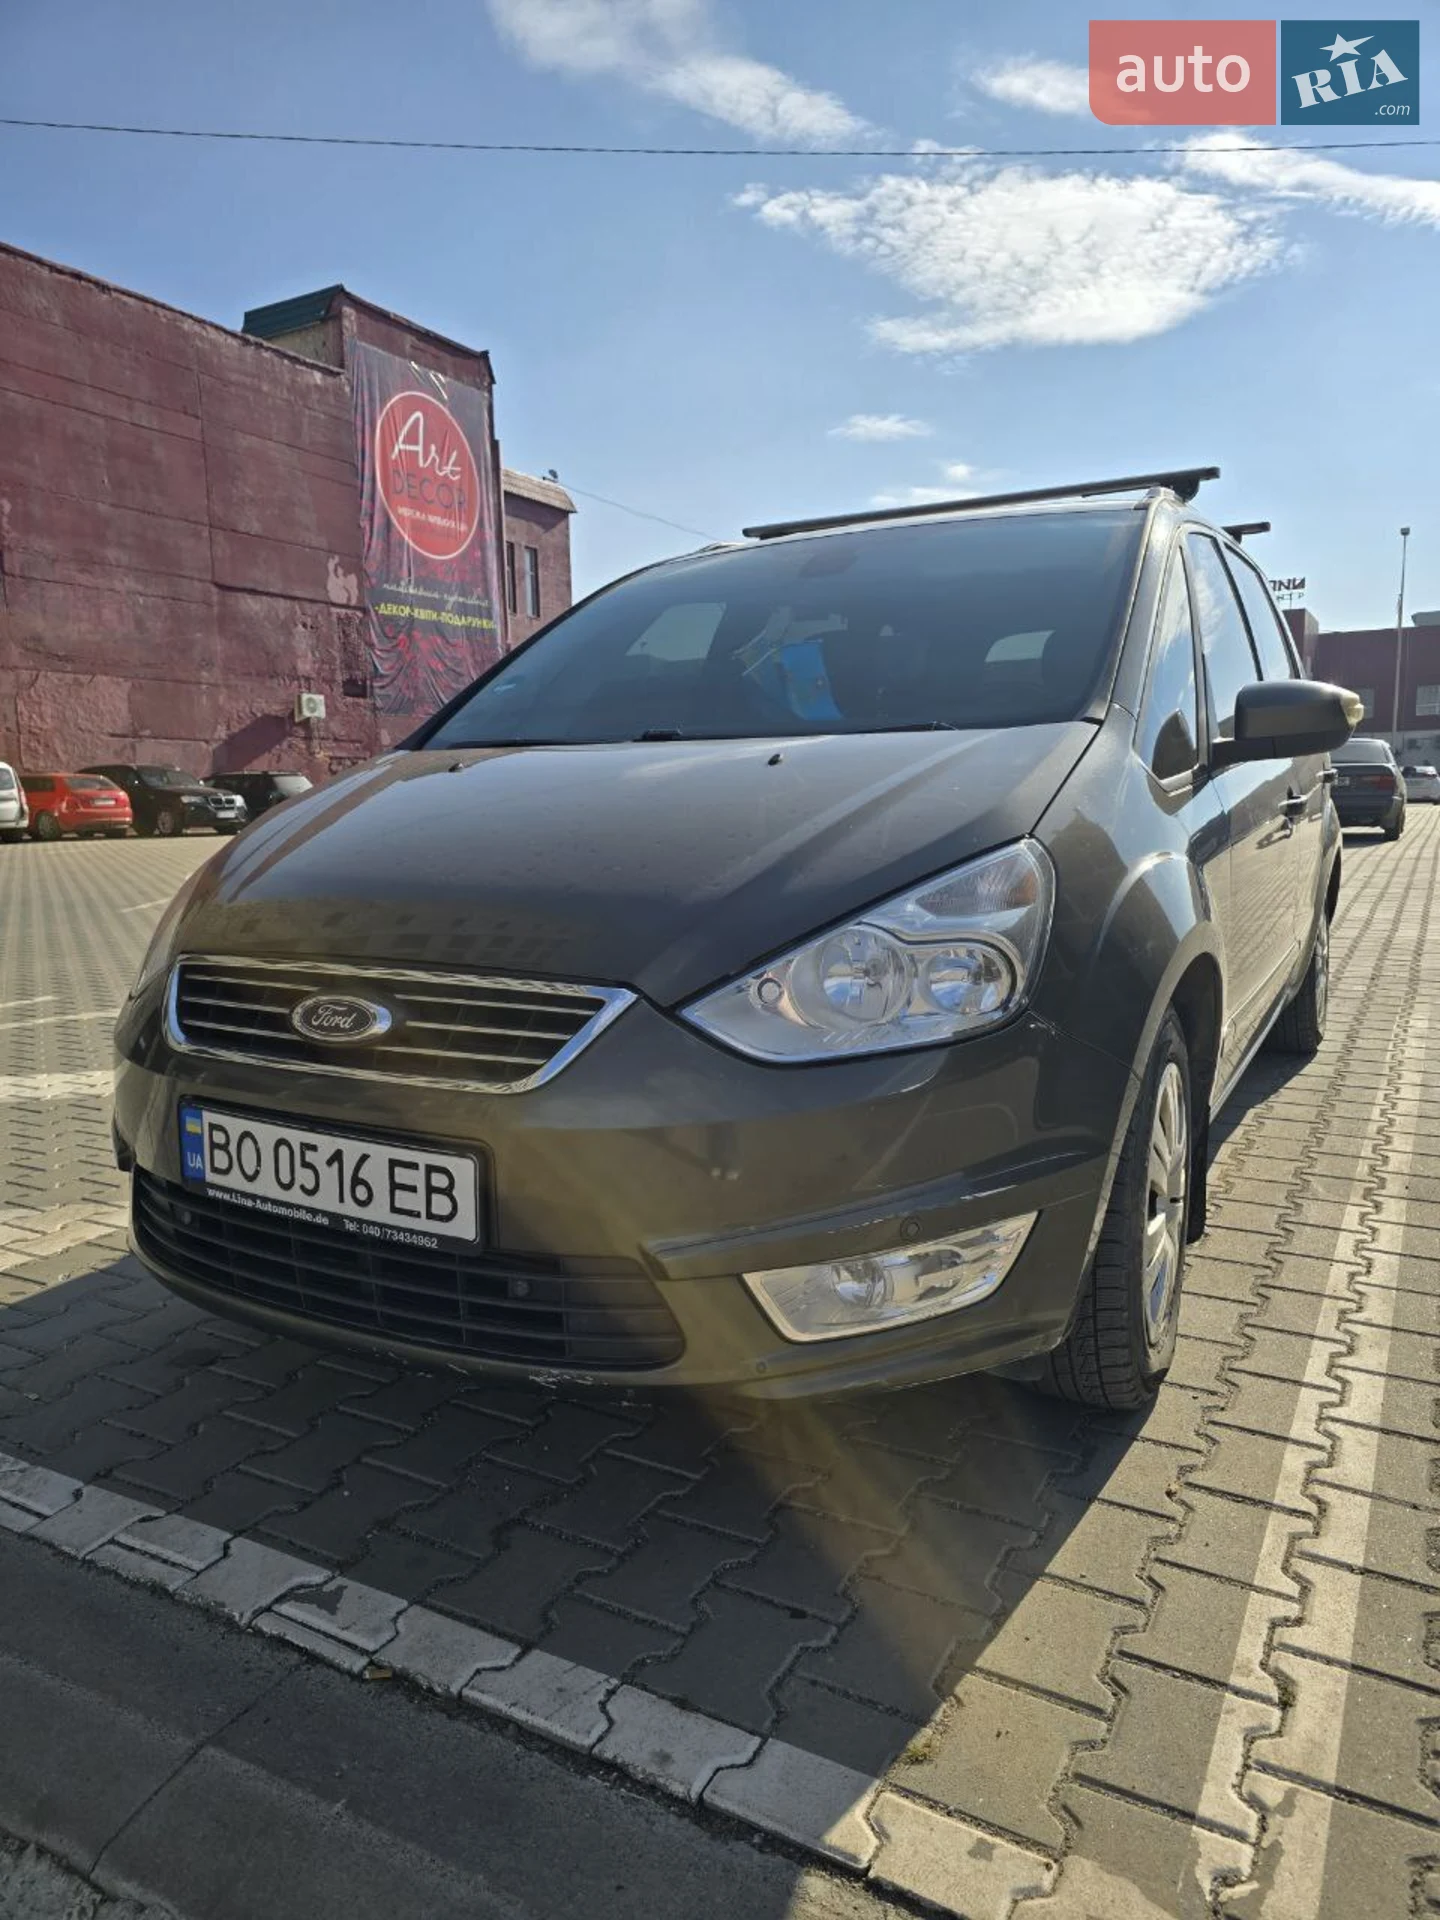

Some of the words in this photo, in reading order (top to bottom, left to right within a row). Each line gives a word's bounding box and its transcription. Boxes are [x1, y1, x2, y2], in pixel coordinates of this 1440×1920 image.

[391, 410, 461, 481] Art
[311, 1004, 357, 1029] Ford
[187, 1151, 204, 1170] UA
[208, 1122, 261, 1183] BO
[273, 1137, 374, 1208] 0516
[388, 1158, 458, 1223] EB
